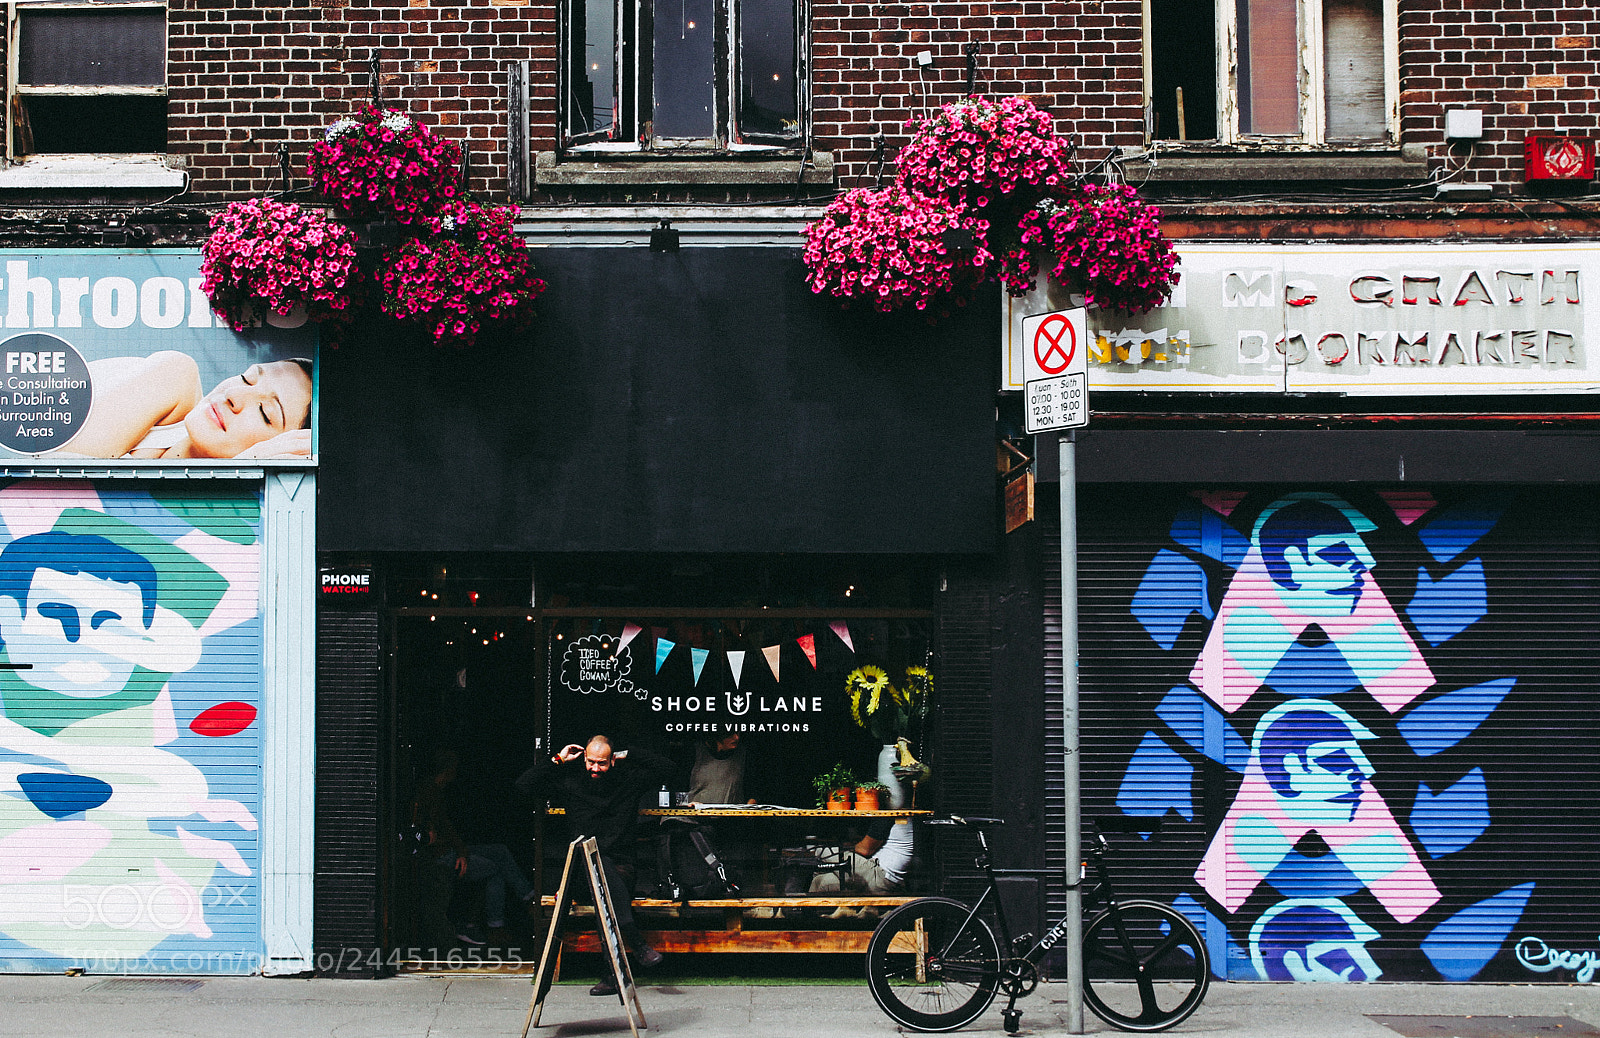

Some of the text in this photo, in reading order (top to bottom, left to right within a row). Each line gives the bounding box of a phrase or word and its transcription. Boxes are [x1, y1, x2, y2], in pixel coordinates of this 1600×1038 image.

[1349, 269, 1580, 308] GRATH
[1237, 330, 1577, 367] BOOKMAKER
[6, 352, 66, 374] FREE
[7, 375, 87, 390] Consultation
[0, 391, 70, 405] n Dublin &
[0, 407, 72, 425] urrounding
[1036, 416, 1054, 426] MON
[1062, 412, 1077, 423] SAT
[15, 423, 54, 437] Areas
[321, 574, 370, 585] PHONE
[321, 585, 360, 594] WATCH
[578, 648, 600, 659] ICED
[579, 658, 619, 672] COFFEE?
[651, 696, 823, 712] SHOE LANE
[665, 723, 810, 732] COFFEE VIBRATIONS
